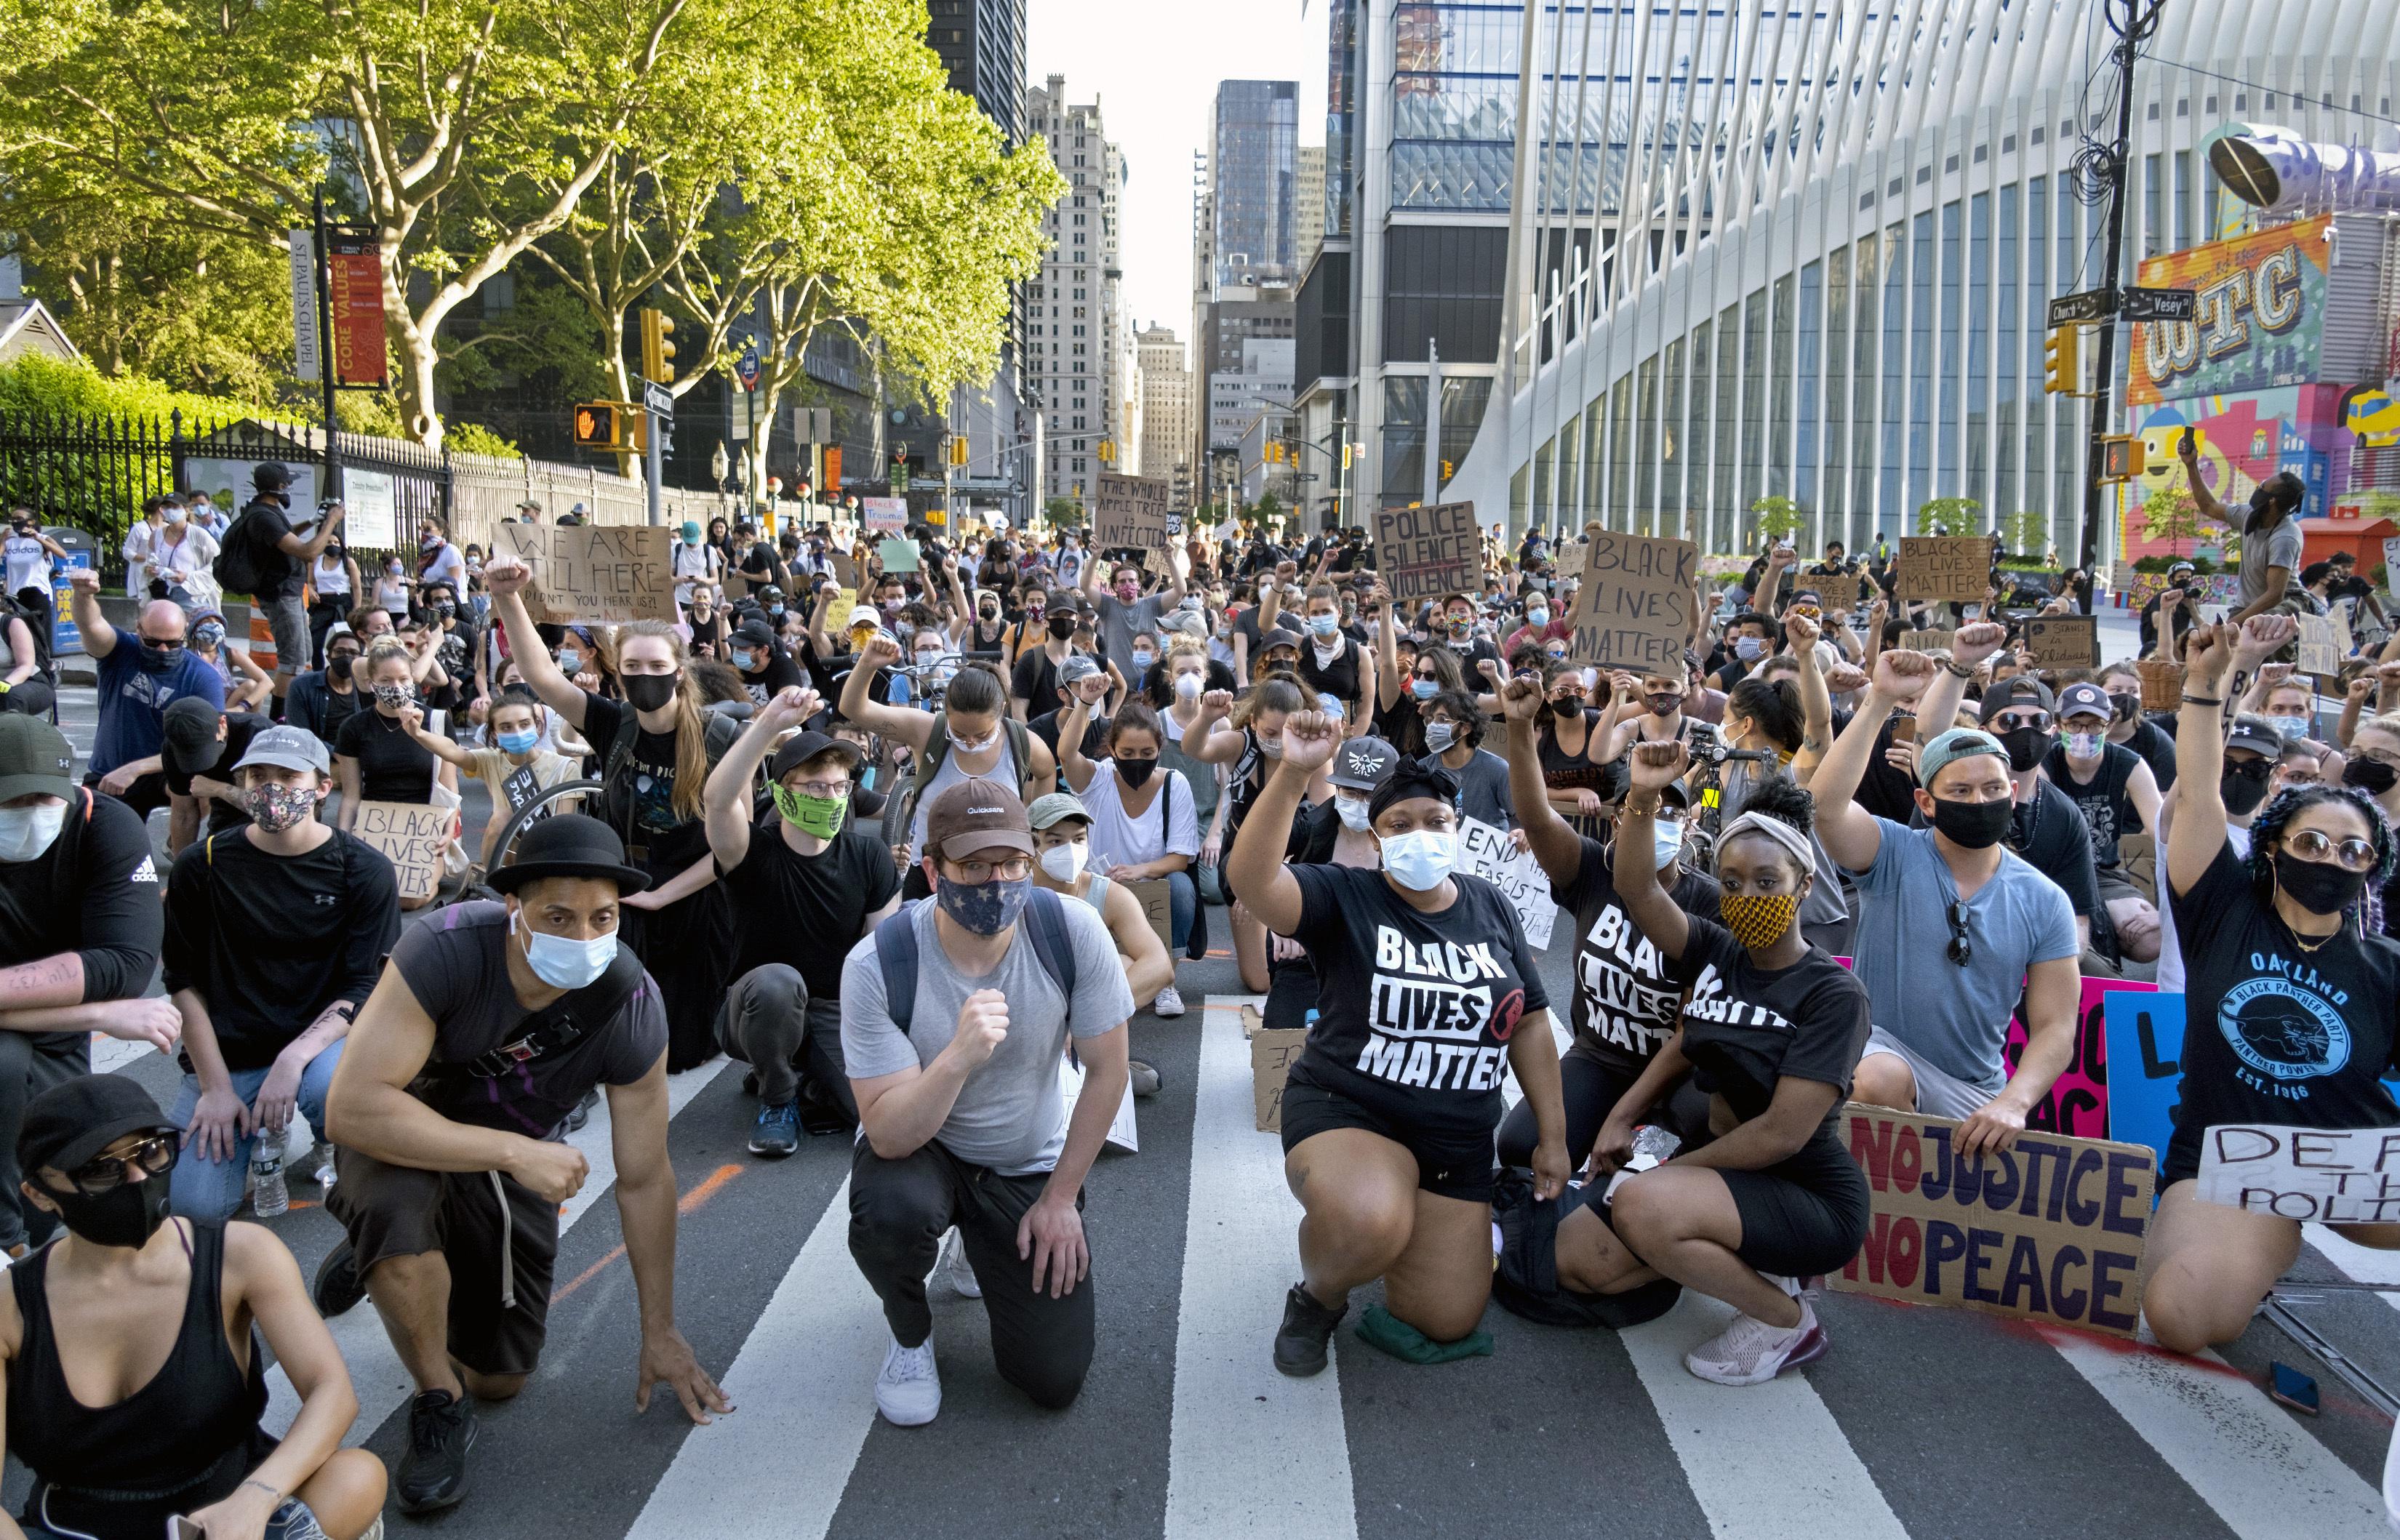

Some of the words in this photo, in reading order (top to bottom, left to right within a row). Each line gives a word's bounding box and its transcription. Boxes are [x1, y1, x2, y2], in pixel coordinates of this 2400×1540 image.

[296, 264, 309, 308] PAUL'S
[335, 260, 351, 320] VALUES
[2053, 305, 2076, 321] Church
[2154, 297, 2182, 319] Vesey
[299, 310, 313, 367] CHAPEL
[339, 326, 353, 370] CORE
[661, 398, 671, 409] WAY
[865, 499, 895, 508] Black
[1100, 479, 1126, 496] THE
[1131, 481, 1167, 502] WHOLE
[866, 509, 903, 521] Trauma
[1098, 499, 1132, 513] APPLE
[1135, 500, 1164, 518] TREE
[1124, 516, 1135, 525] is
[1378, 505, 1467, 543] POLICE
[509, 527, 569, 559] WE
[588, 529, 649, 559] ARE
[1102, 524, 1166, 548] INFECTED
[1905, 542, 1964, 558] BLACK
[1383, 534, 1472, 572] SILENCE
[1593, 537, 1692, 589] BLACK
[1930, 557, 1975, 571] LIVES
[523, 558, 582, 593] TILL
[592, 562, 664, 593] HERE
[1386, 564, 1475, 599] VIOLENCE
[1800, 575, 1836, 586] BLACK
[1812, 585, 1847, 595] LIVES
[1906, 574, 1979, 595] MATTER
[525, 590, 564, 604] DIDN'T
[574, 595, 598, 606] YOU
[604, 595, 632, 606] HEAR
[637, 596, 657, 609] US?!
[1593, 582, 1683, 627] LIVES
[1823, 595, 1851, 609] TTER
[1904, 635, 1945, 651] BLACK
[2053, 623, 2085, 634] STAND
[1574, 625, 1679, 667] MATTER
[364, 808, 443, 837] BLACK
[967, 806, 1005, 815] Quicksand
[1465, 827, 1519, 863] END
[394, 862, 433, 895] TER
[1475, 859, 1545, 907] FASCIST
[1517, 907, 1556, 938] STATE
[1376, 924, 1508, 984] BLACK
[1587, 903, 1679, 984] BLA
[1578, 954, 1679, 1021] LIVES
[2251, 953, 2348, 1006] OAKLAND
[1375, 982, 1486, 1033] LIVES
[2236, 982, 2271, 1001] BLACK
[2276, 982, 2323, 1012] PANTHER
[2321, 1012, 2345, 1044] PARTY
[2231, 1038, 2276, 1074] PANTHER
[2236, 1067, 2268, 1094] EST.
[2273, 1083, 2309, 1100] 1966
[2215, 1127, 2400, 1173] DEF
[1849, 1116, 1921, 1194] NO
[1920, 1126, 2151, 1238] JUSTICE
[2319, 1172, 2400, 1199] TH
[2239, 1187, 2400, 1222] POLI
[1842, 1212, 1921, 1288] NO
[1924, 1219, 2137, 1331] PEACE
